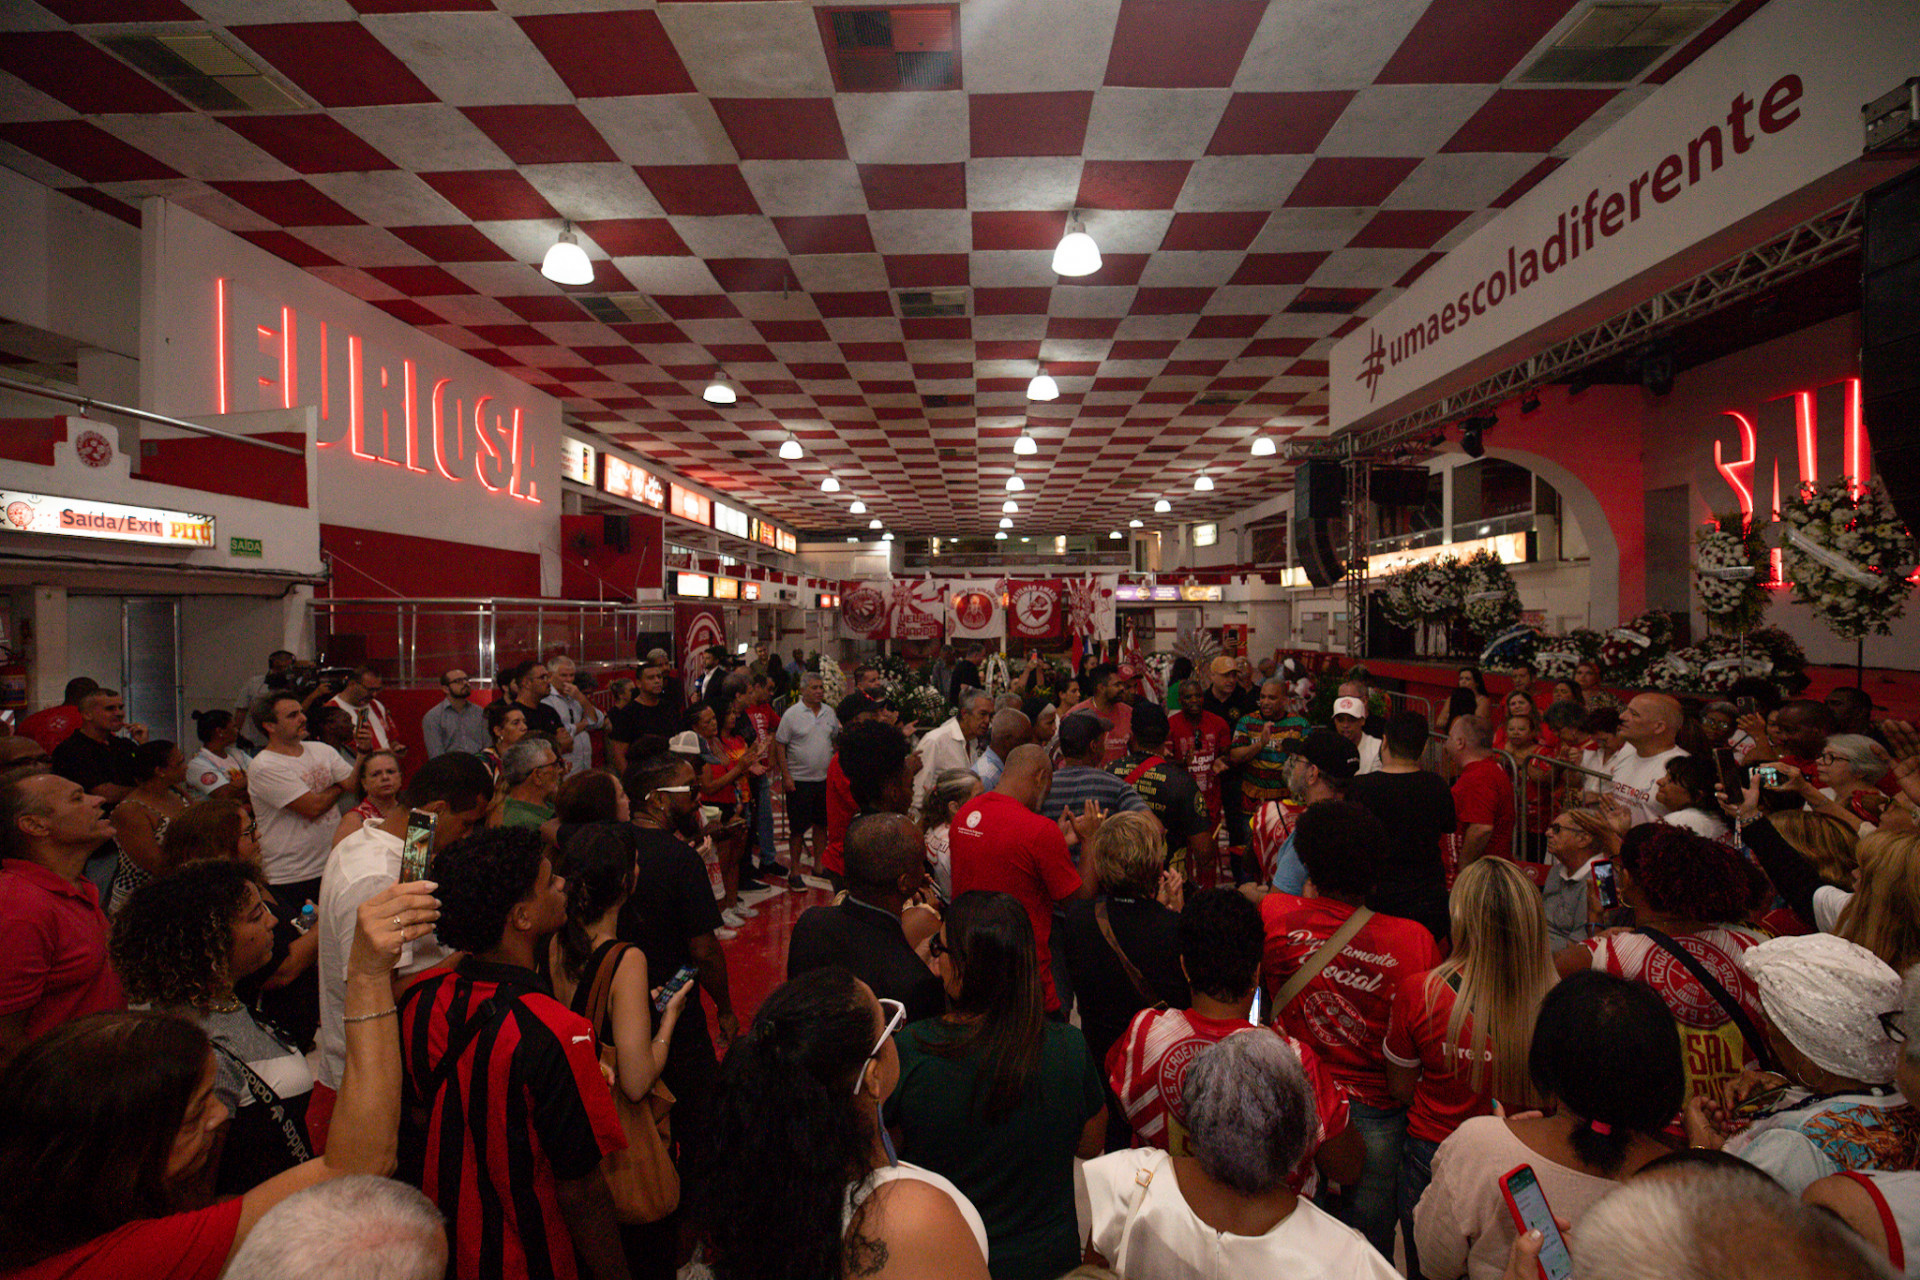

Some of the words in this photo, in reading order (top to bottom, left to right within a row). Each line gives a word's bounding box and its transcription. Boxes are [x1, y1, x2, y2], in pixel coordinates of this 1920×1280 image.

[1356, 73, 1804, 403] #umaescoladiferente
[62, 507, 161, 535] Saída/Exit
[1686, 1034, 1740, 1076] SAL
[234, 1060, 274, 1104] adidas
